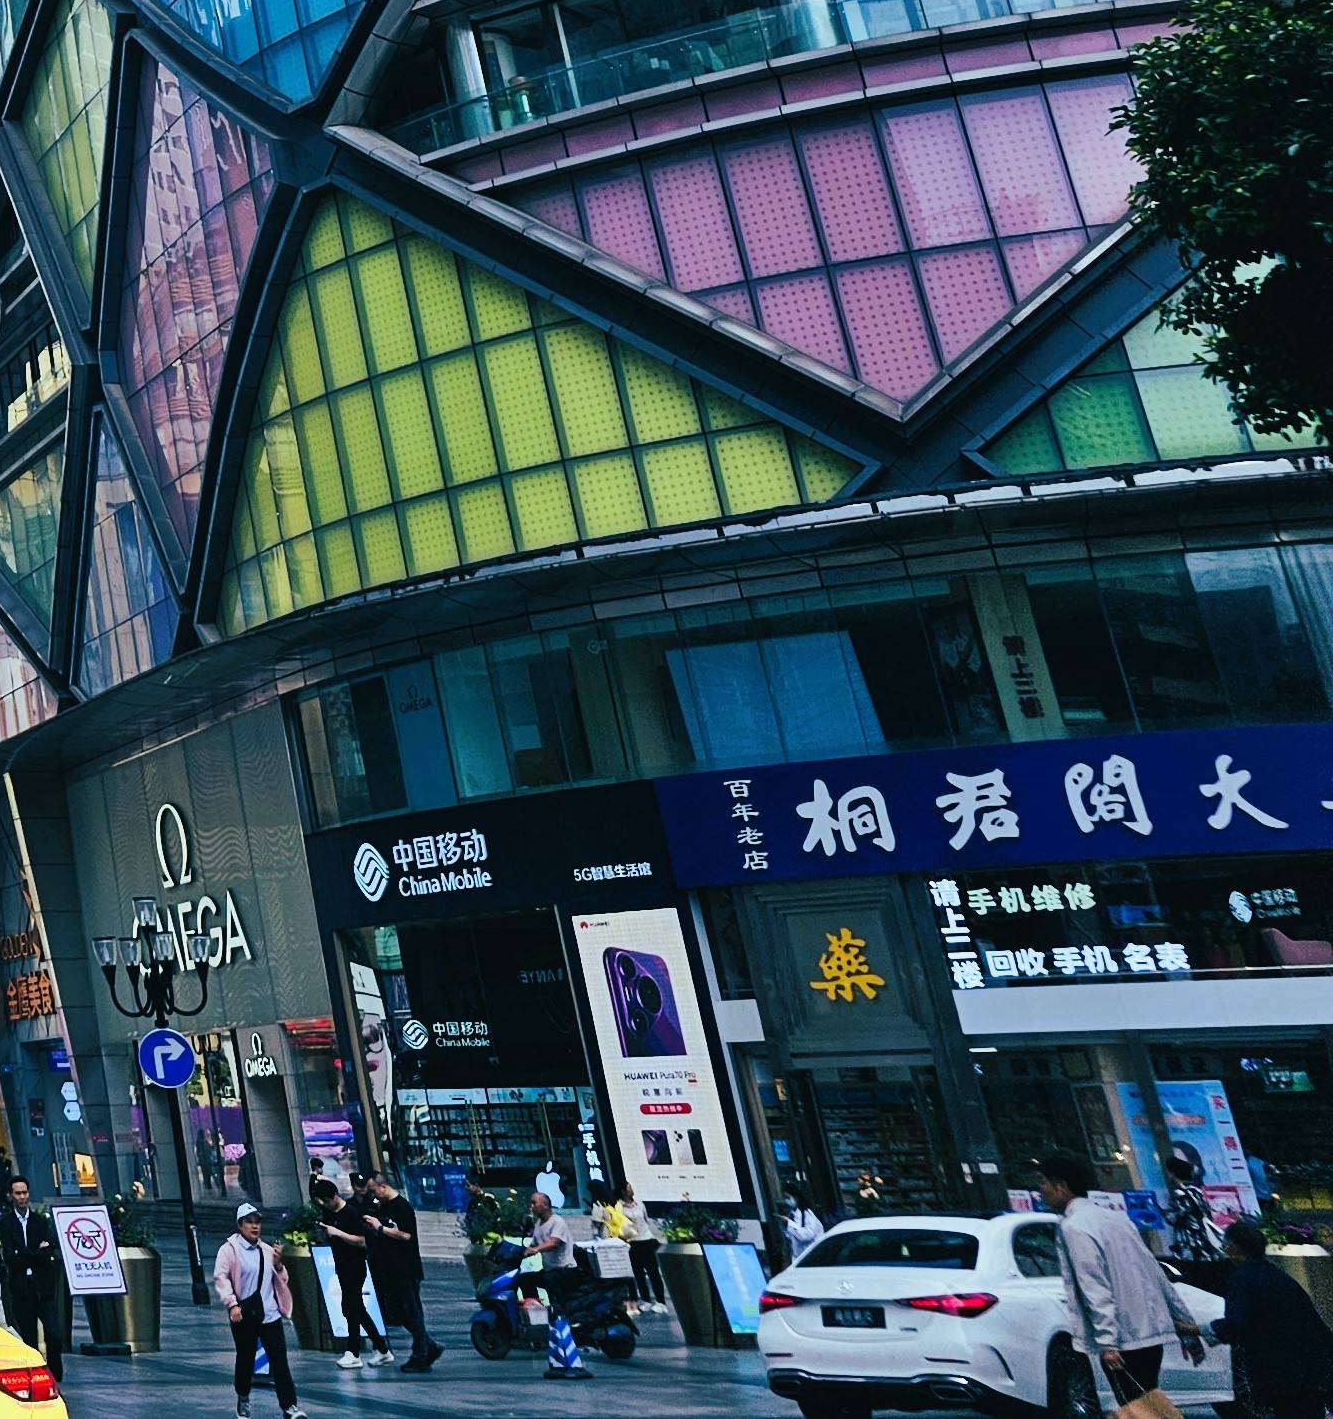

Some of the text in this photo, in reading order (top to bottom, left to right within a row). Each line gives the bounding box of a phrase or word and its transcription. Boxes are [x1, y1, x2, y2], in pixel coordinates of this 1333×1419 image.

[795, 754, 1333, 857] 桐君閣大
[723, 779, 769, 870] 百年老店
[392, 829, 489, 872] 中国移动
[573, 862, 653, 883] 5G智慧生活馆
[967, 883, 1097, 915] 手机维修
[928, 879, 985, 990] 请上二楼
[985, 942, 1191, 978] 回收 手机 名表
[433, 1021, 488, 1036] 中国移动
[244, 1055, 277, 1078] OMEGA
[624, 1071, 658, 1081] HUAWEI
